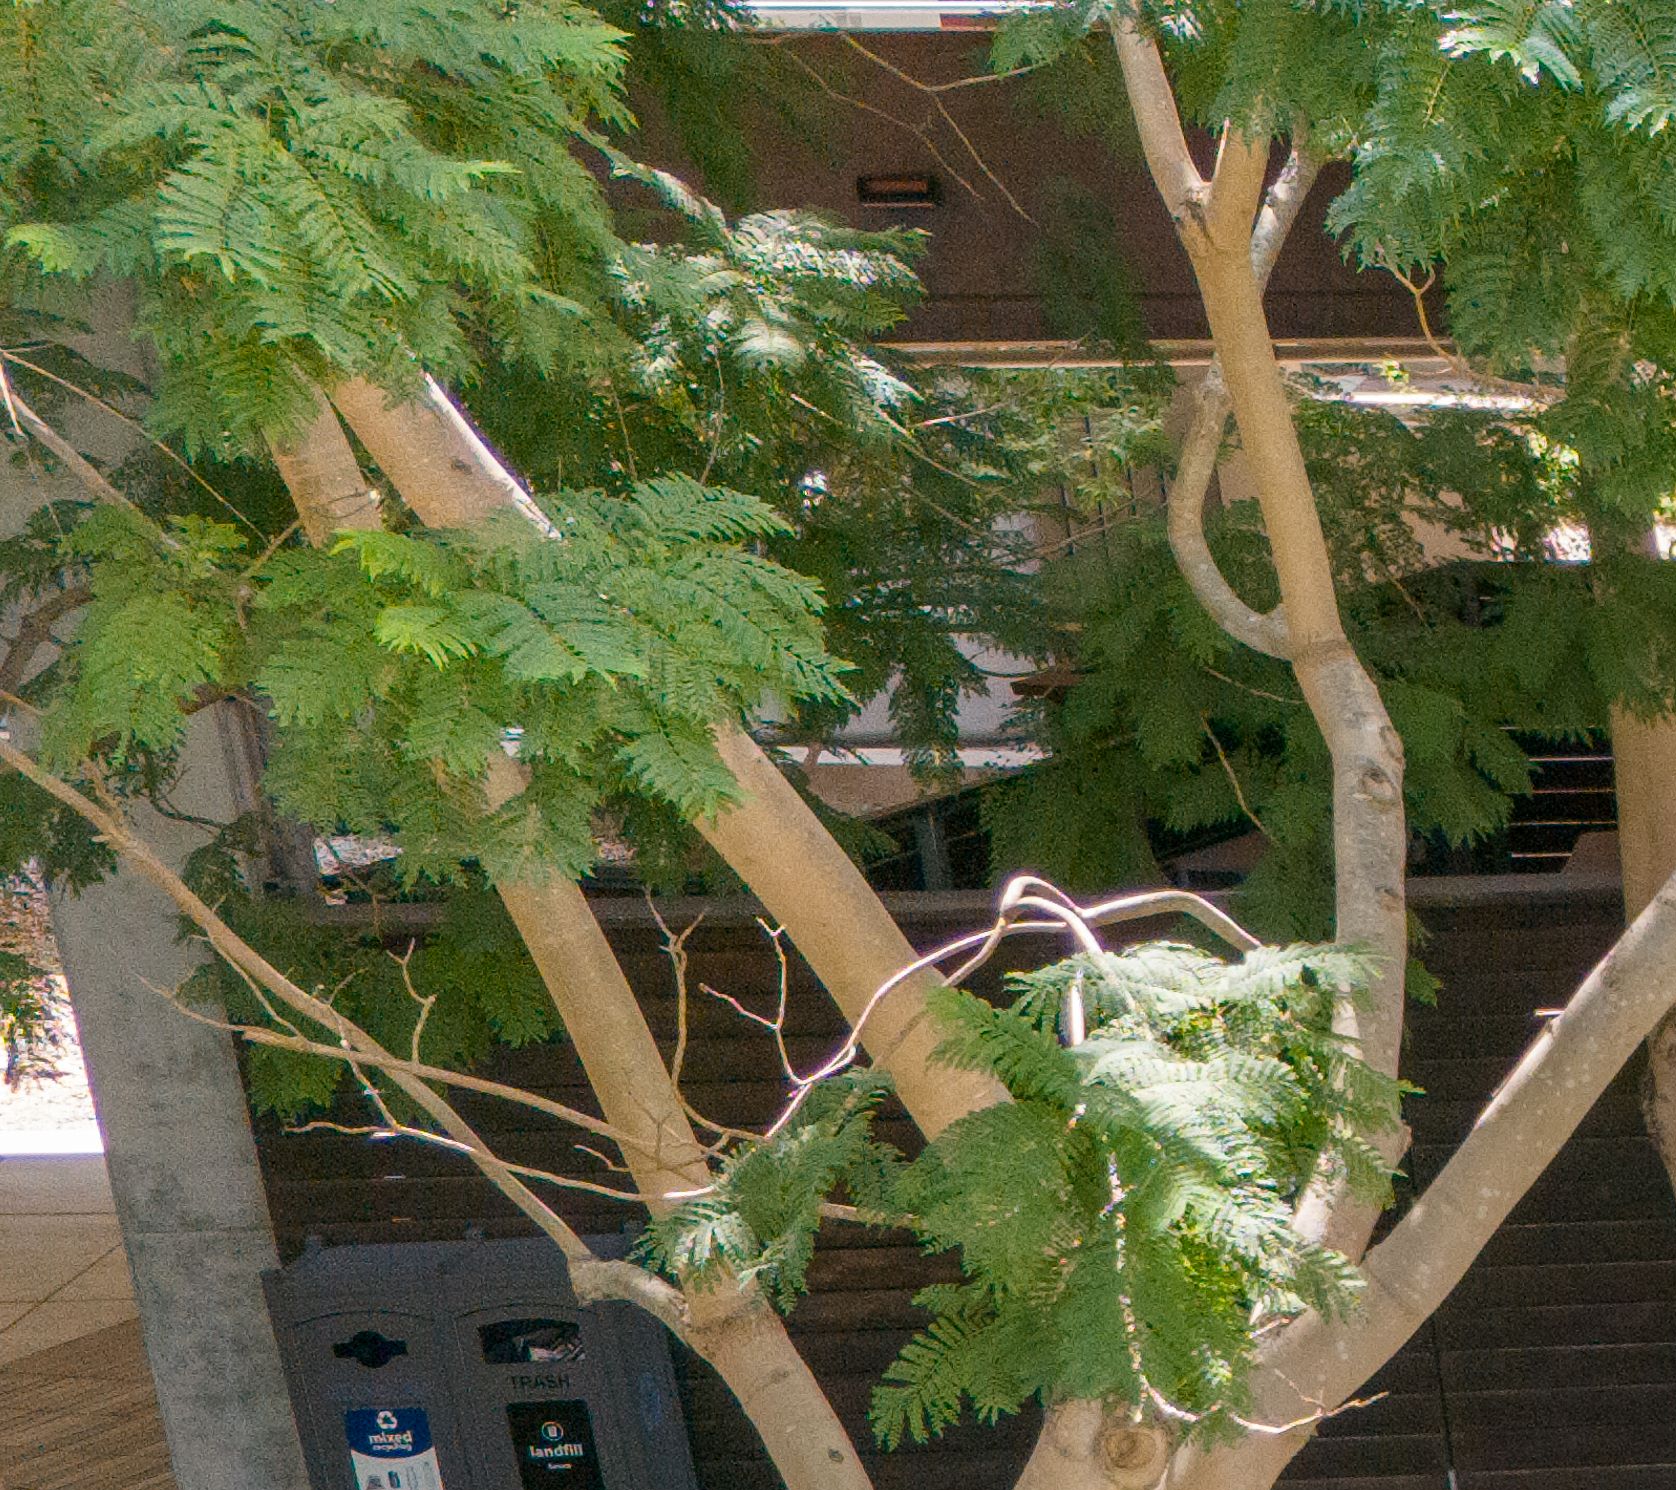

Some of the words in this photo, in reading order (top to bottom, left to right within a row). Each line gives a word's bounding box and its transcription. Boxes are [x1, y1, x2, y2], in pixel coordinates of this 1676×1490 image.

[510, 1374, 571, 1390] TRASH
[368, 1430, 413, 1445] mixed
[529, 1443, 584, 1458] landfill
